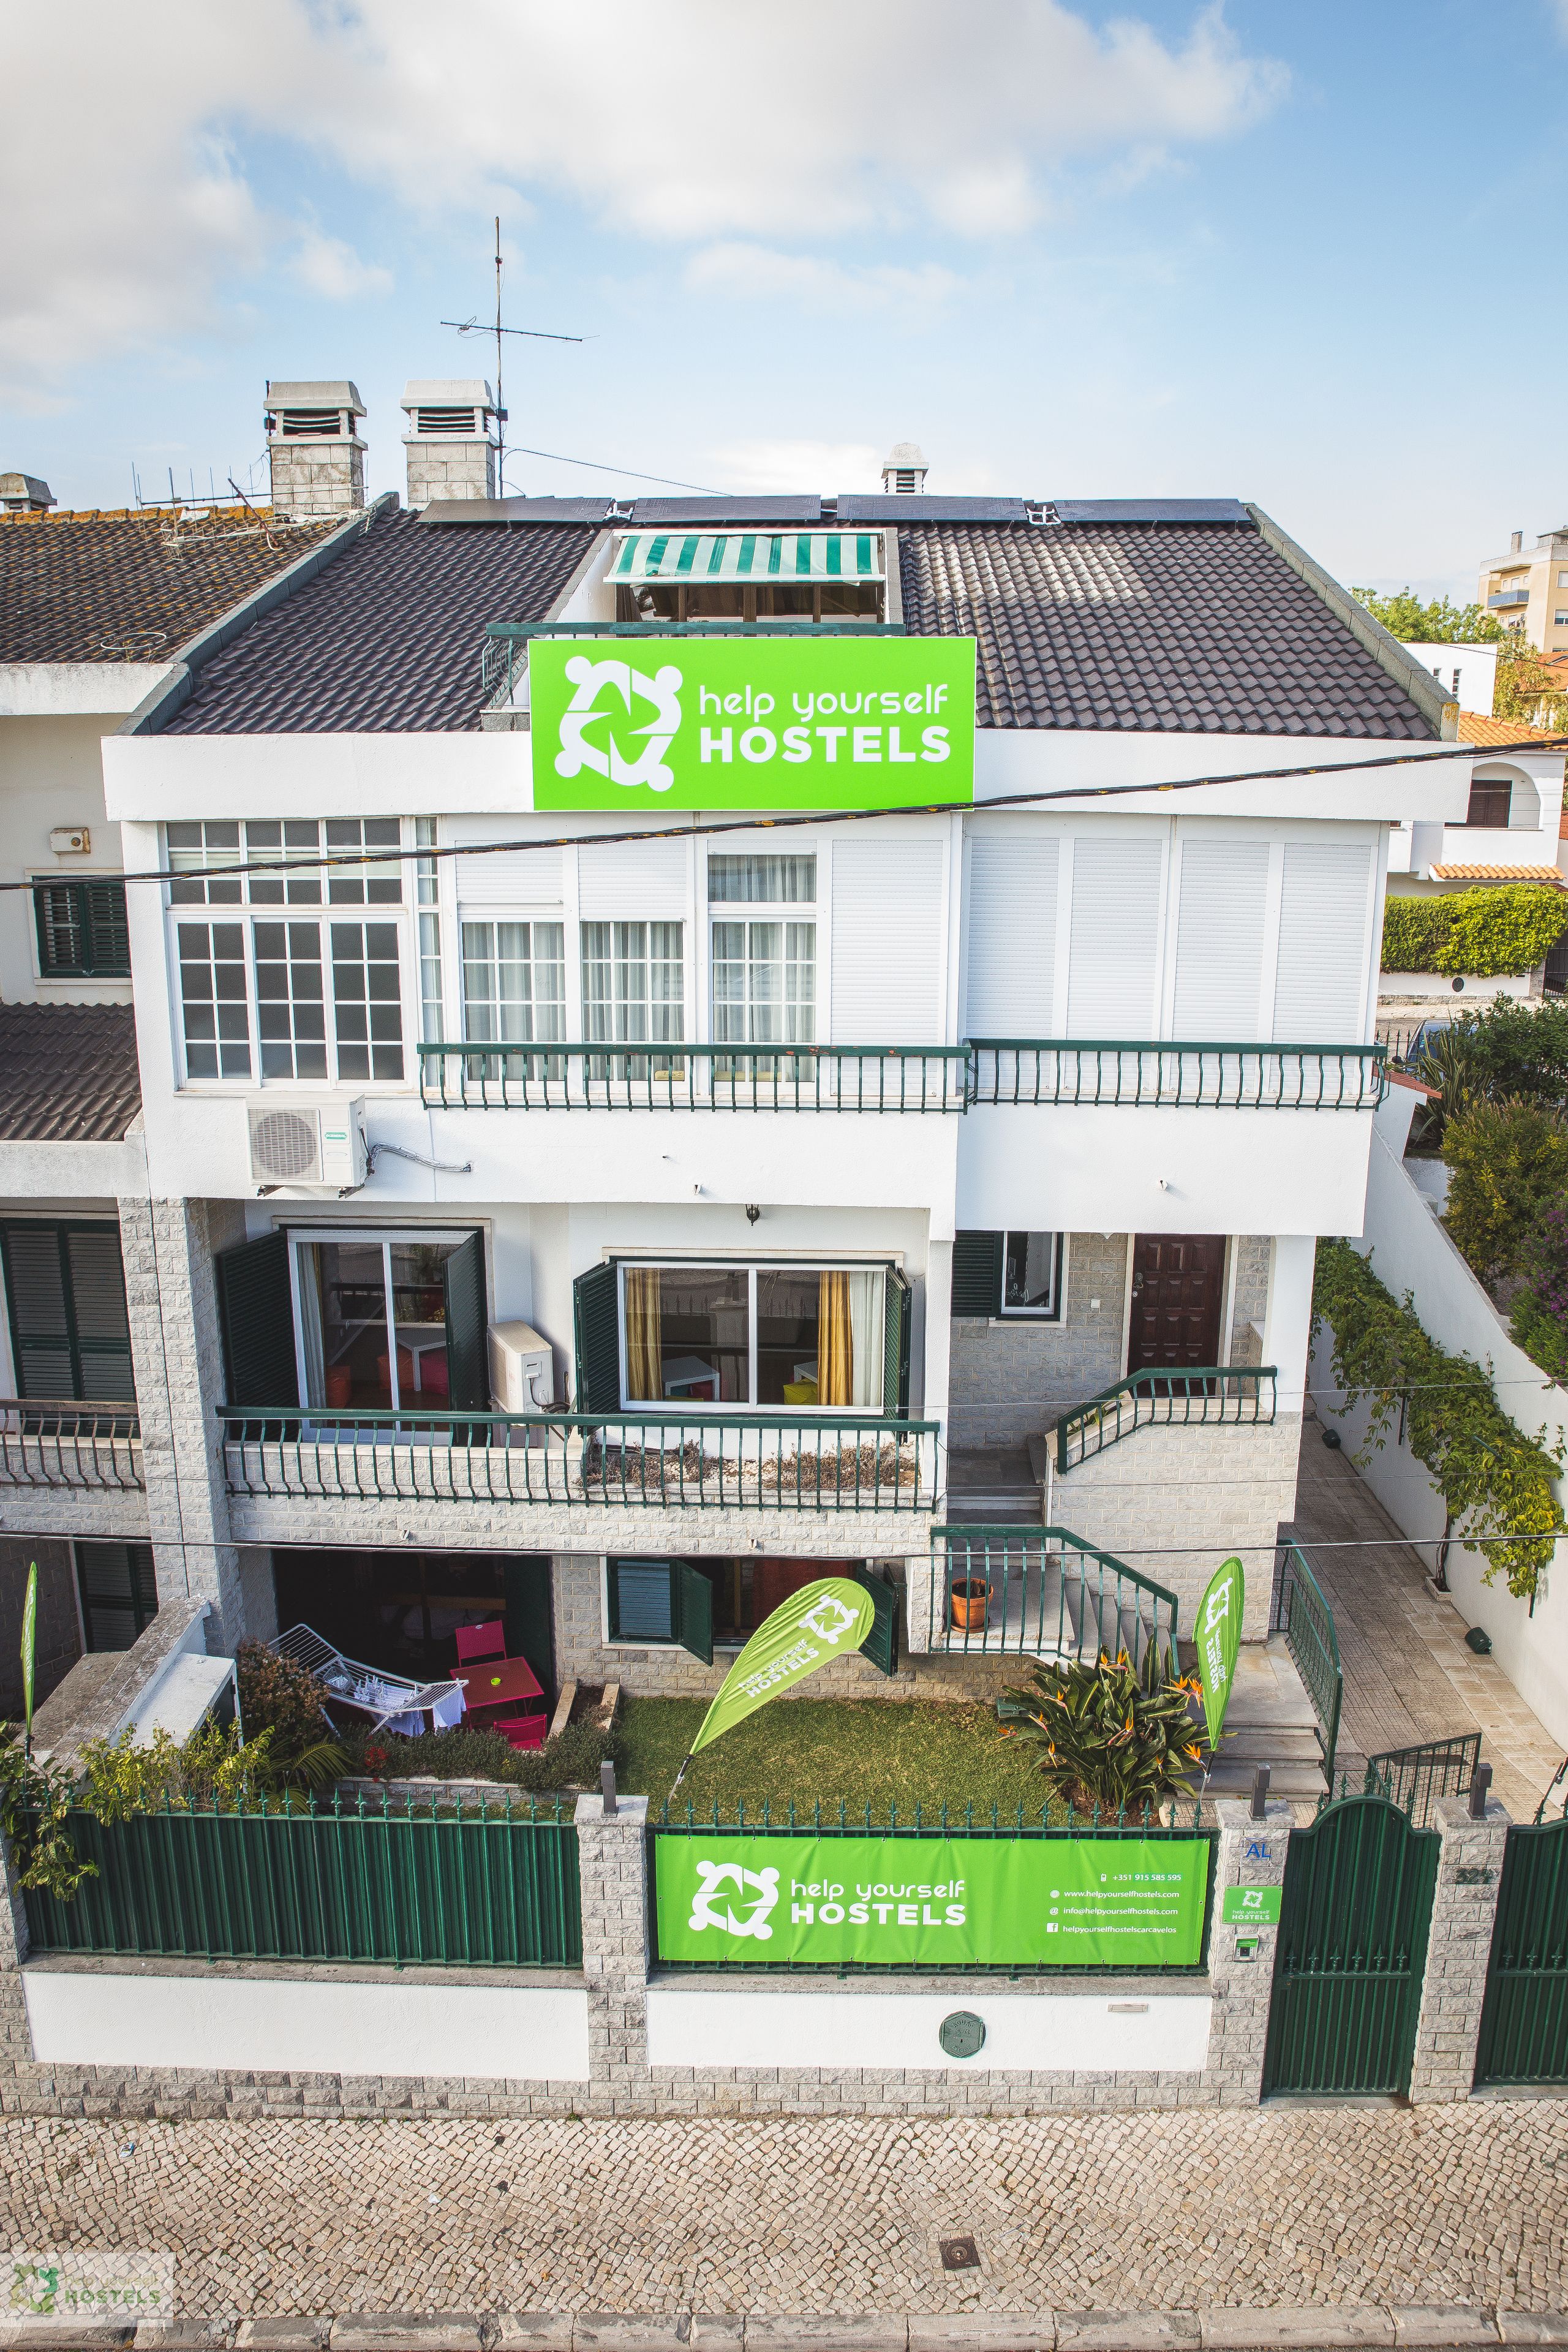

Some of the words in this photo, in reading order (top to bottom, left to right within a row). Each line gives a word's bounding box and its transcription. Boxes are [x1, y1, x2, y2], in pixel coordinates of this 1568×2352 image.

[699, 685, 775, 723] help
[793, 684, 948, 723] yourself
[700, 726, 951, 763] HOSTELS
[737, 1673, 763, 1689] help
[764, 1638, 808, 1673] yourself
[745, 1648, 820, 1698] HOSTELS
[1245, 1842, 1272, 1858] AL
[791, 1879, 845, 1901] help
[856, 1880, 965, 1902] yourself
[1063, 1890, 1180, 1899] www.helpyourselfhostels.com
[791, 1902, 966, 1926] HOSTELS
[1063, 1907, 1178, 1916] info@helpyourselfhostels.com
[1063, 1925, 1177, 1934] helpyourselfhostelscarcavelos
